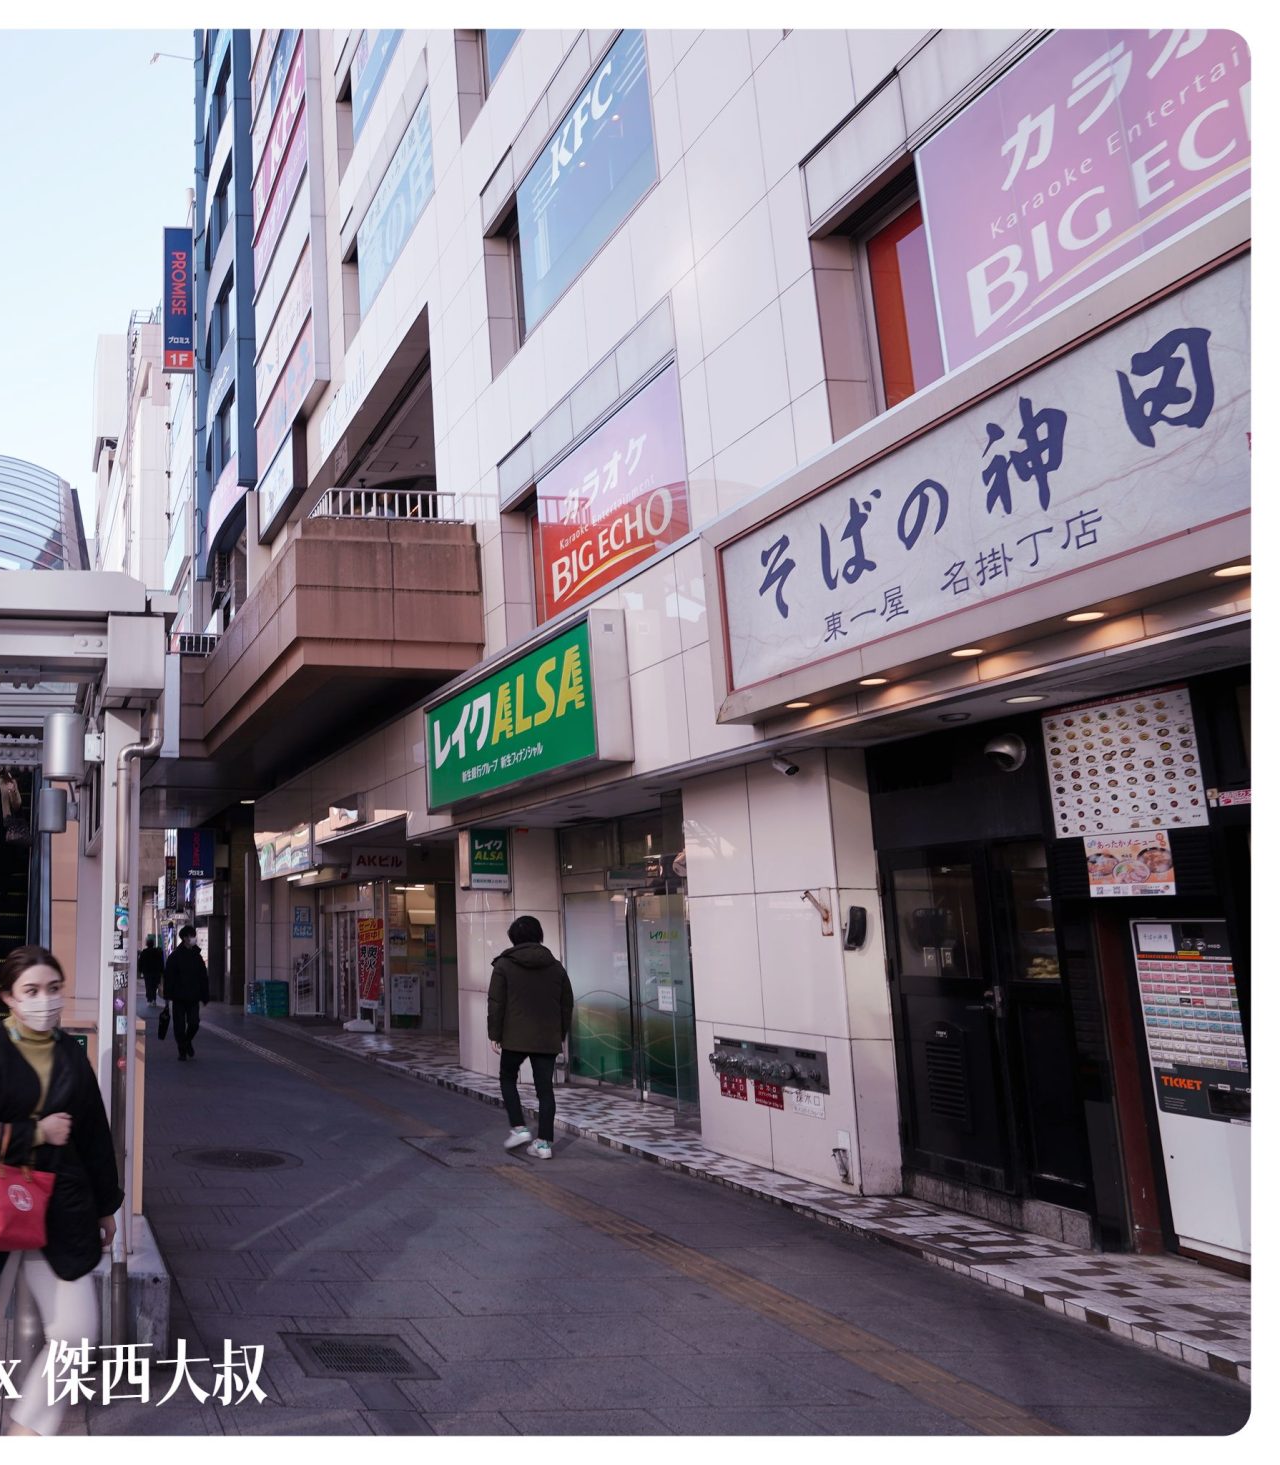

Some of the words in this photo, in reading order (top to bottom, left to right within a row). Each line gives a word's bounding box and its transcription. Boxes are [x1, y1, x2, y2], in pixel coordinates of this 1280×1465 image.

[271, 60, 303, 181] KFC
[550, 61, 613, 188] KFC
[991, 157, 1094, 240] Karaoke
[1108, 44, 1251, 157] Entertai
[966, 186, 1112, 338] BIG
[1132, 80, 1251, 210] EC
[171, 252, 187, 316] PROMISE
[168, 336, 191, 345] プロミス
[170, 353, 188, 366] 1F
[559, 523, 589, 549] Karaoke
[592, 474, 656, 527] Entertainment
[563, 434, 647, 526] カラオケ
[551, 540, 594, 603] BIG
[599, 488, 673, 561] ECHO
[823, 584, 909, 645] 東一屋
[940, 508, 1104, 597] 名掛丁店
[500, 742, 543, 769] 新生フィナンシャル
[356, 854, 403, 869] AKビル
[474, 839, 503, 850] レイク
[474, 850, 504, 861] ALSA
[1161, 1075, 1202, 1091] TICKET
